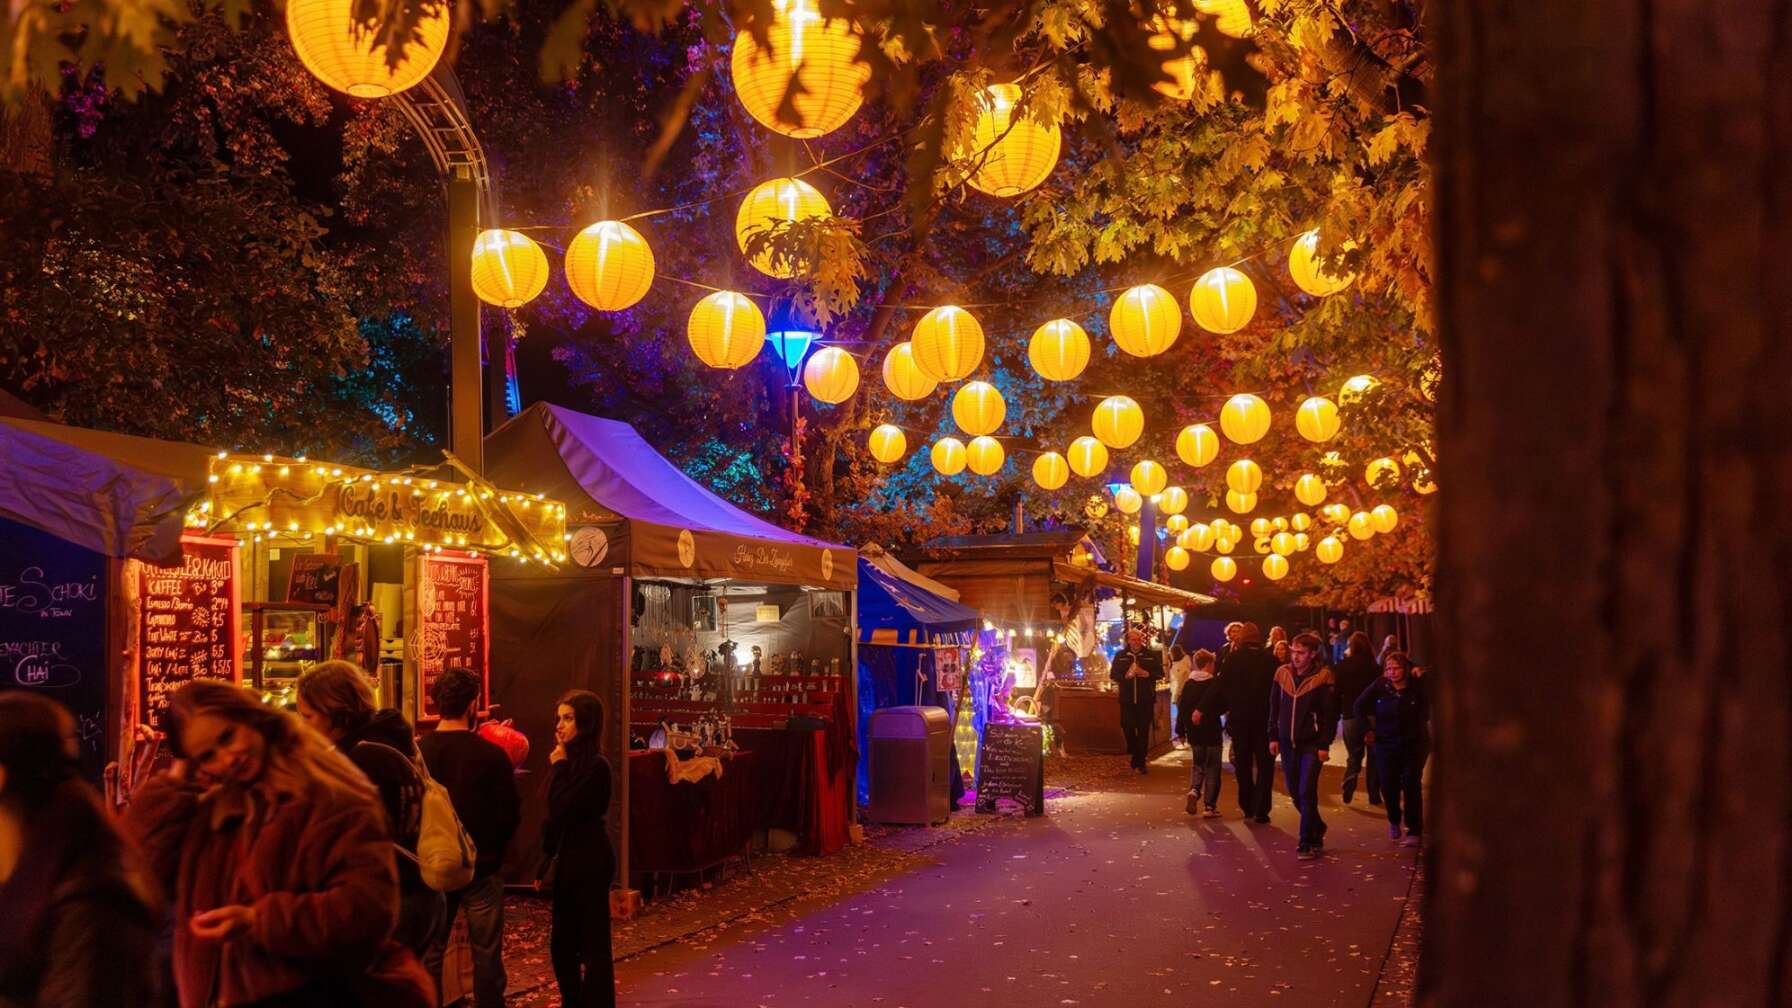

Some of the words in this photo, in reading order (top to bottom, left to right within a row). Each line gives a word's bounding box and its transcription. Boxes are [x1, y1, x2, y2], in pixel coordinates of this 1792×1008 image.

[391, 491, 403, 520] &
[409, 496, 482, 532] Teehaus
[147, 579, 183, 596] KAFFEE
